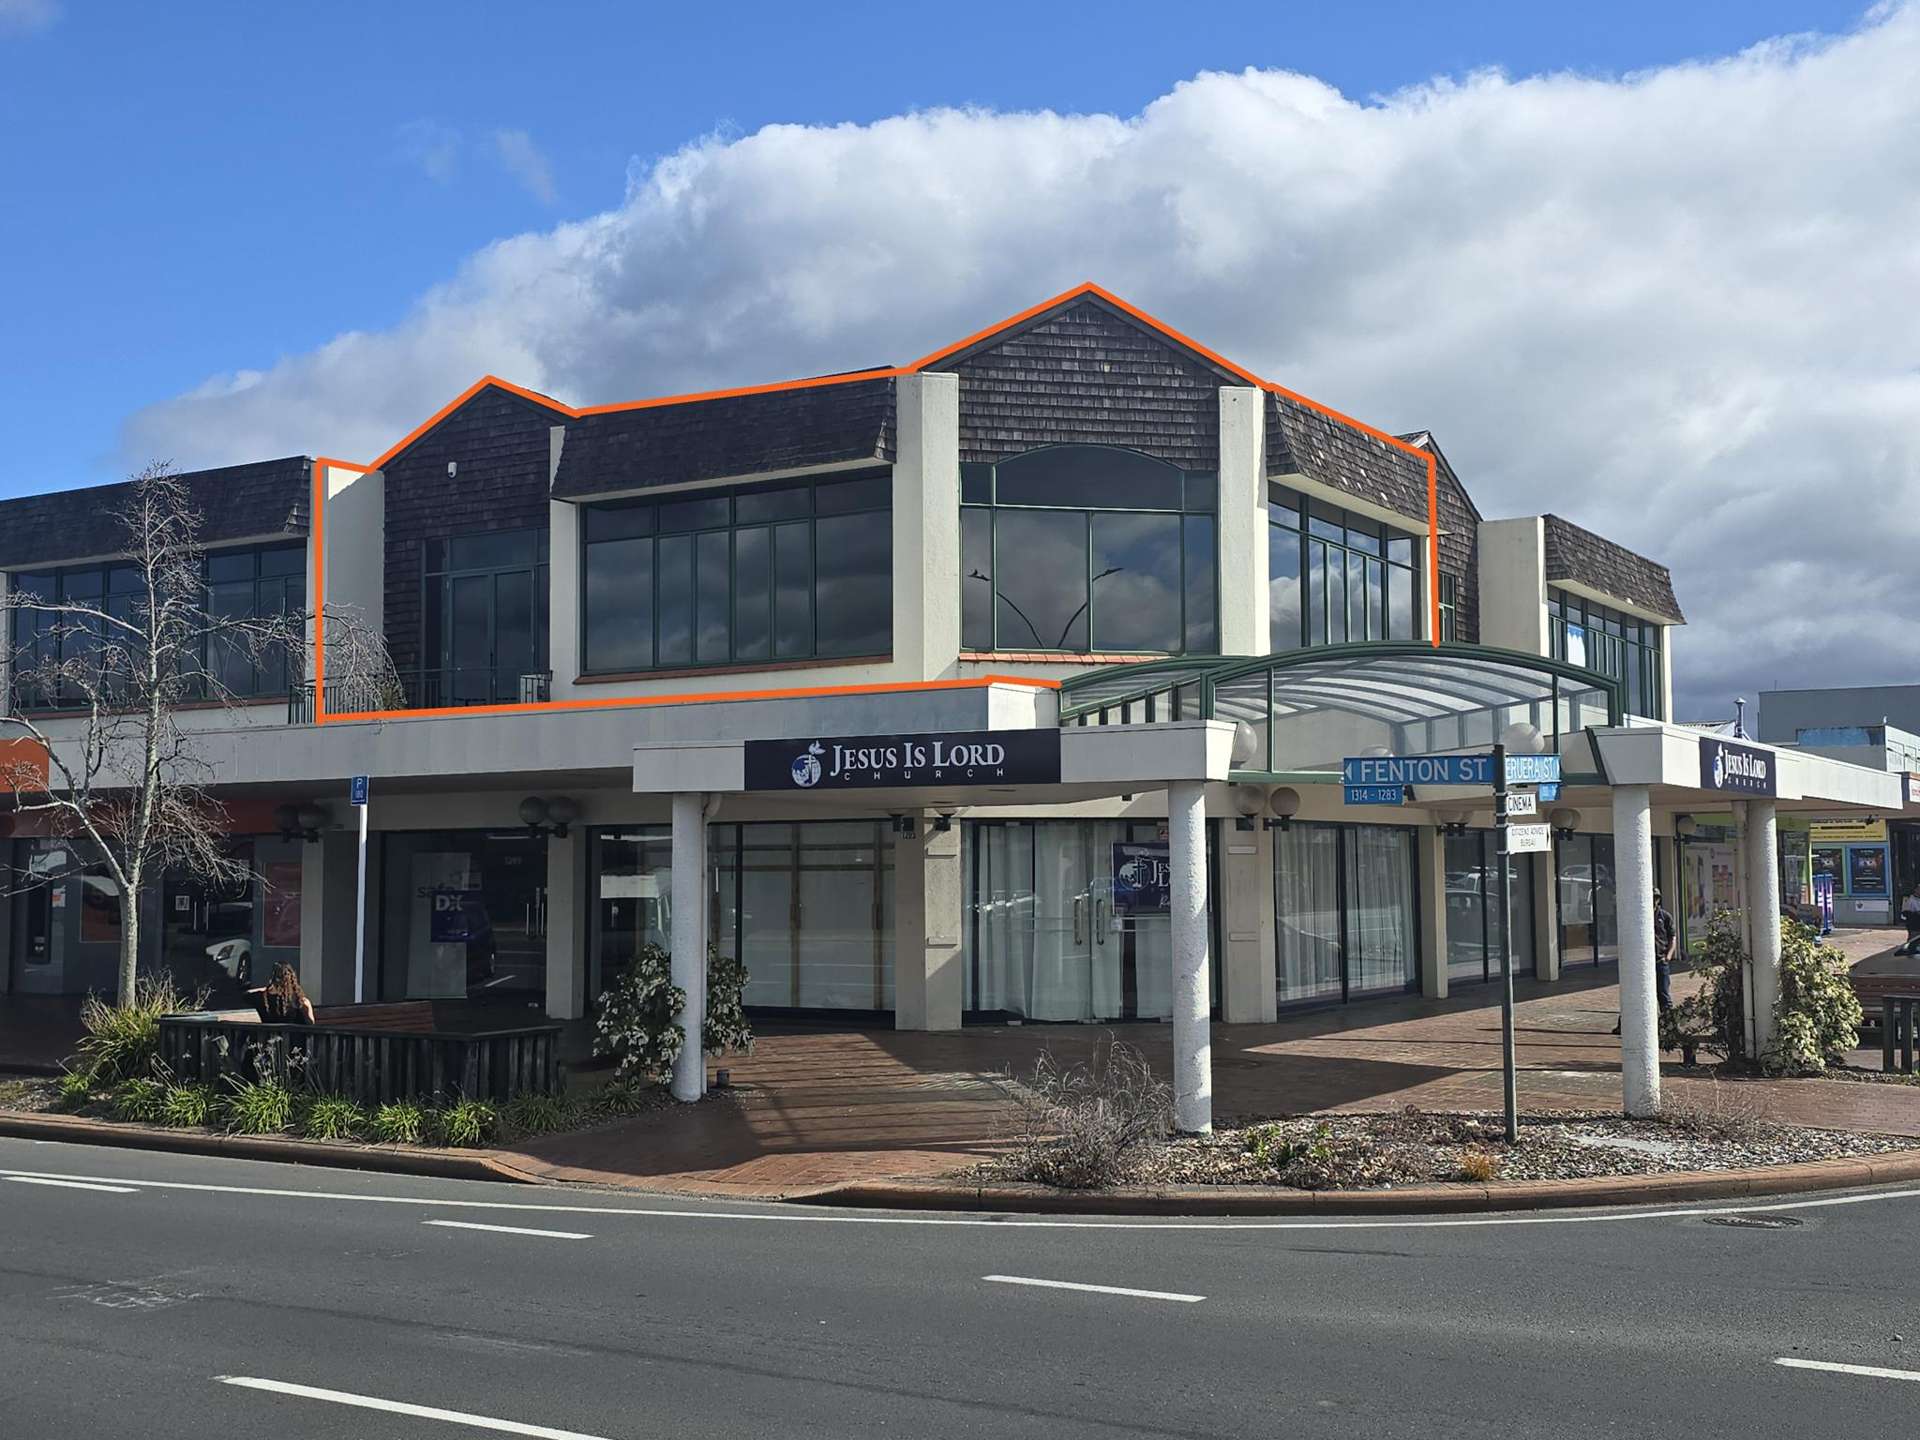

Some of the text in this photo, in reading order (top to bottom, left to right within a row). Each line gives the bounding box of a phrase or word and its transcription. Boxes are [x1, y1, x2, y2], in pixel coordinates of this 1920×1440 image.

[830, 741, 1005, 777] JESUS IS LORD
[1724, 749, 1743, 780] JESUS
[843, 767, 1004, 781] CHURCH
[1361, 758, 1487, 782] FENTON ST
[1505, 757, 1554, 780] ERUERA ST
[356, 777, 363, 788] P
[1351, 789, 1368, 801] 1314
[1378, 788, 1397, 801] 1283
[1507, 796, 1533, 812] CINEMA
[435, 894, 465, 912] DX
